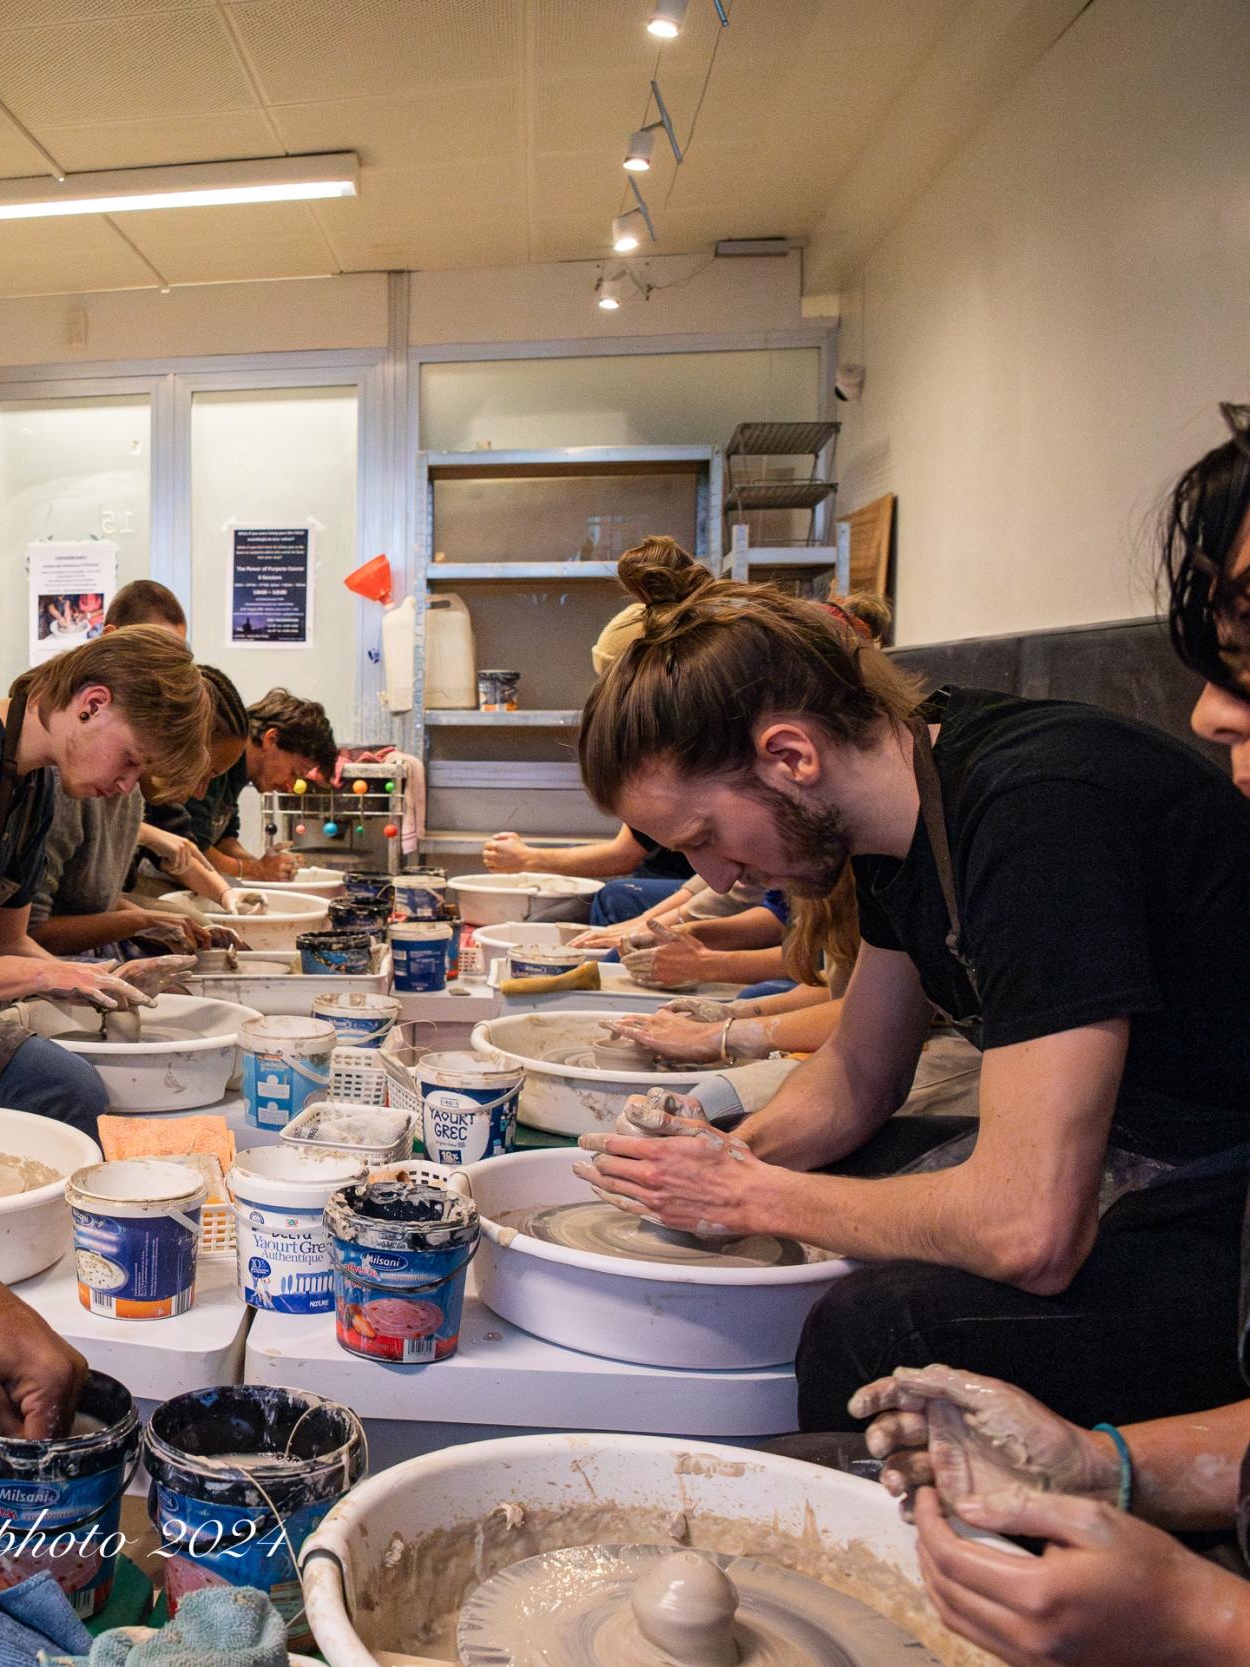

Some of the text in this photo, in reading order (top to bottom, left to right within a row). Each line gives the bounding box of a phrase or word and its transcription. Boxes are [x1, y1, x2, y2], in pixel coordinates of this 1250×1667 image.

[434, 1122, 468, 1141] GREC
[253, 1234, 299, 1253] Yaourt
[261, 1249, 324, 1266] Authentique
